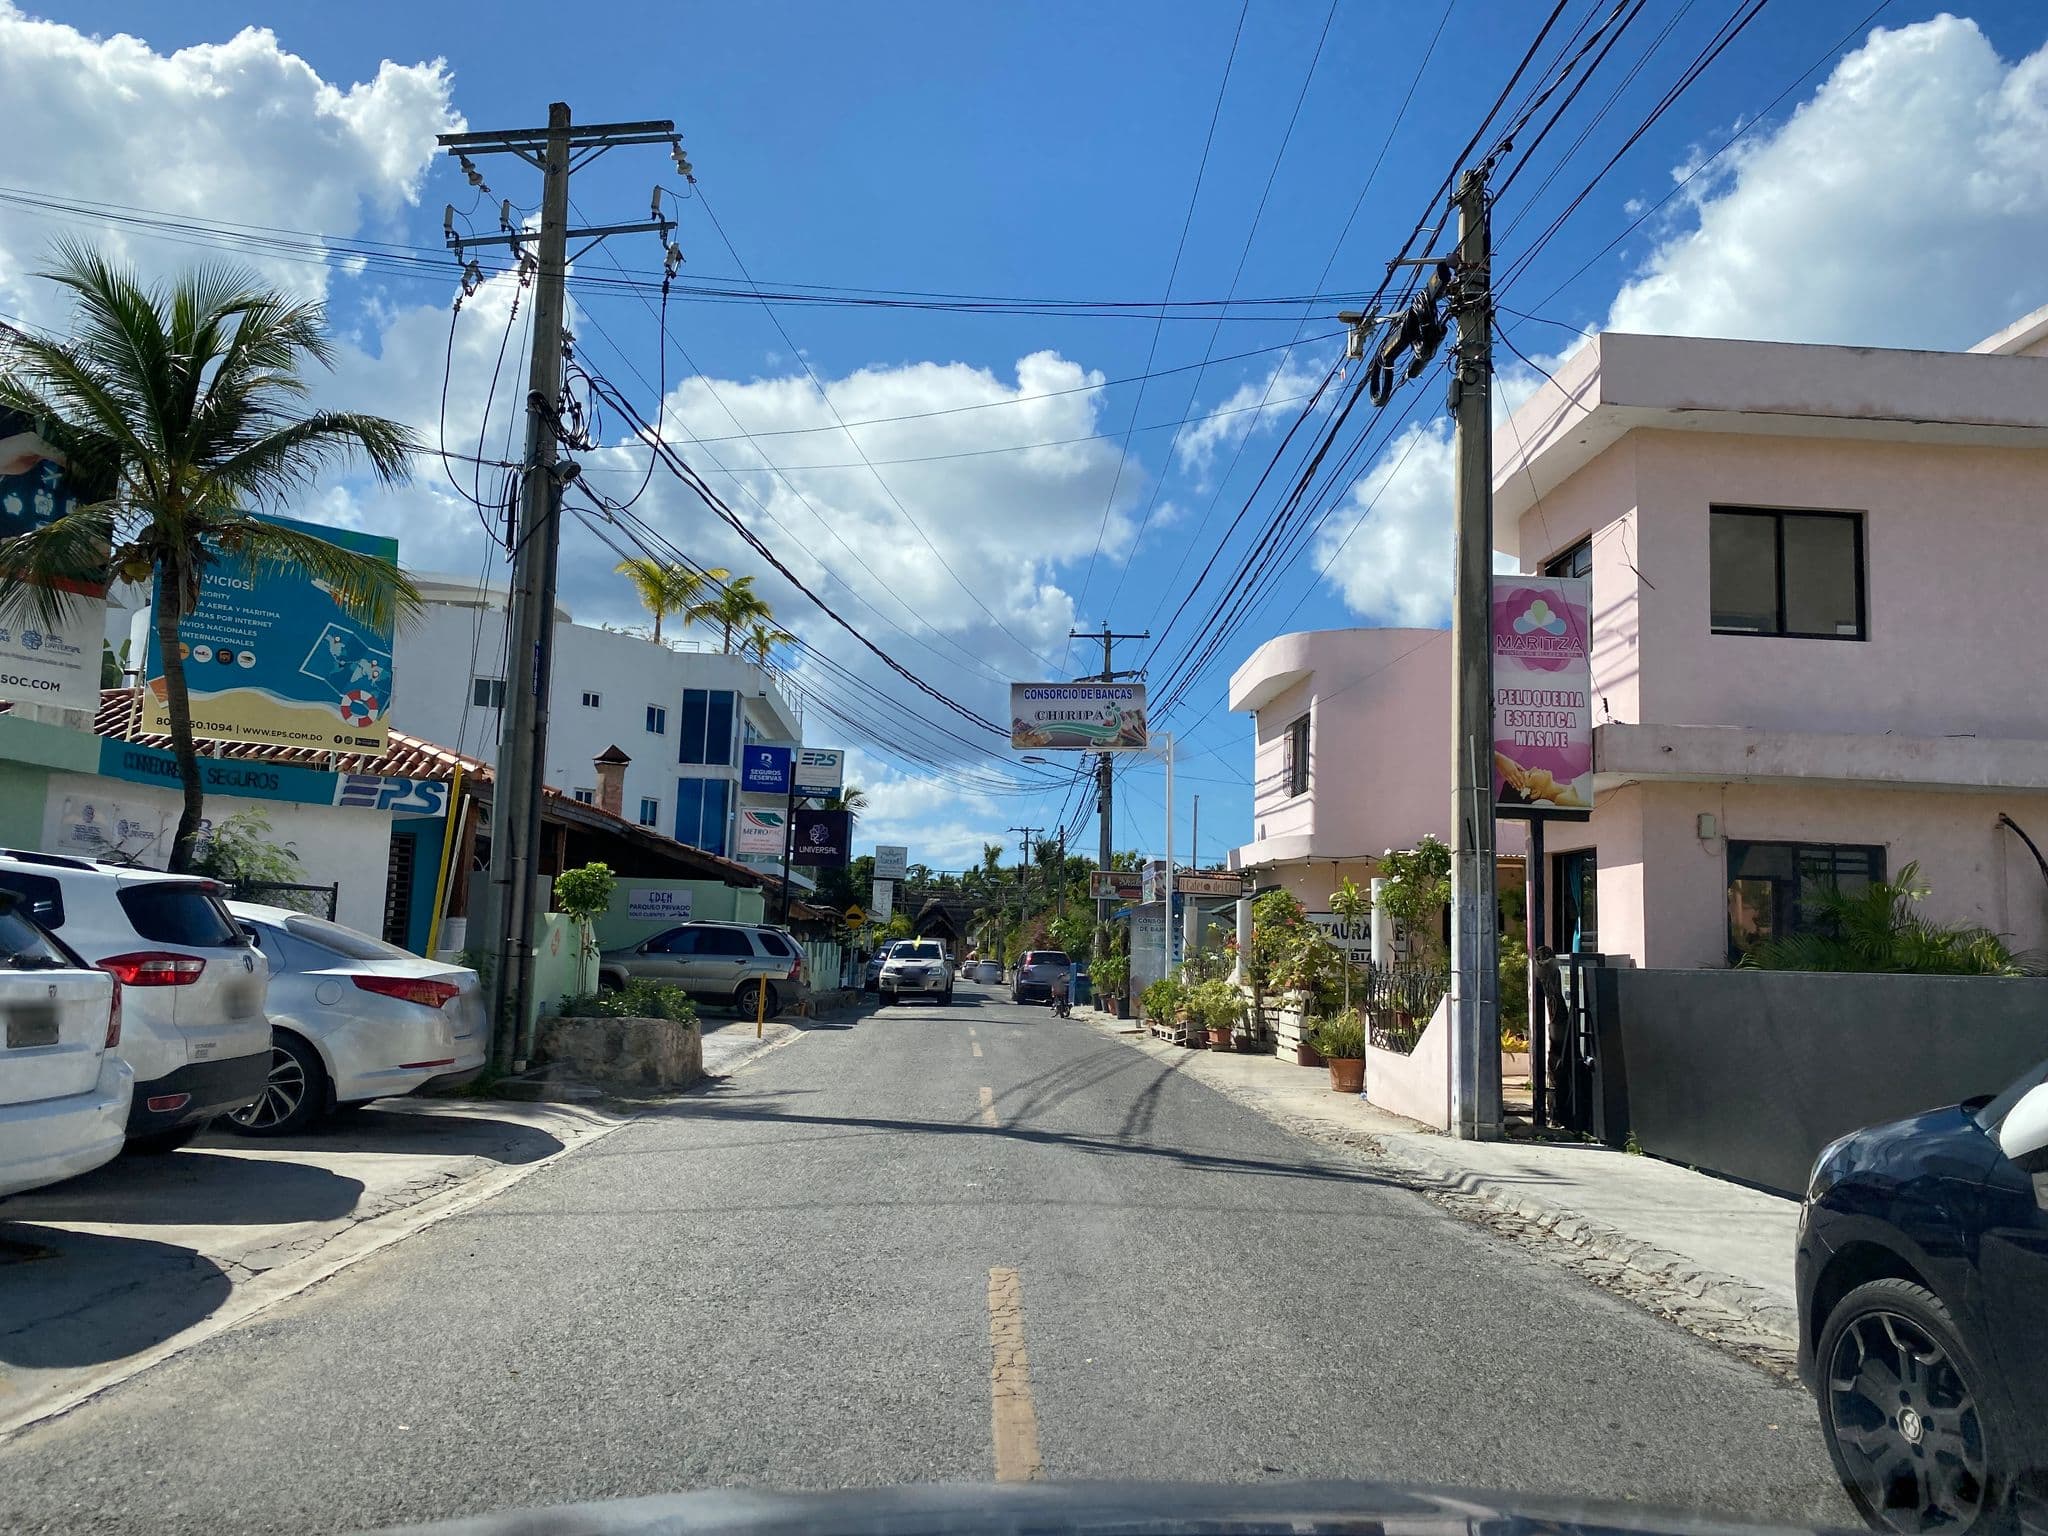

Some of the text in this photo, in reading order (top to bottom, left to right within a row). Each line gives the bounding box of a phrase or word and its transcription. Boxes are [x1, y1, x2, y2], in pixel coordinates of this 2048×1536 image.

[207, 601, 233, 612] AEREA
[242, 607, 280, 619] MARITIMA
[180, 620, 258, 637] NVIOS NACIONALES
[216, 614, 233, 622] POR
[235, 617, 272, 628] INTERNET
[181, 631, 255, 647] INTERNACIONALES
[1497, 635, 1583, 652] MARITZA
[1024, 688, 1133, 700] CONSORCIO DE BANCAS
[1498, 688, 1584, 707] PELUQUERIA
[1034, 710, 1104, 721] CHIRIPA
[1505, 710, 1576, 728] ESTETICA
[243, 726, 323, 742] WWW.EPS.COM.DO
[1515, 731, 1568, 748] MASAJE
[800, 752, 837, 766] EPS
[207, 767, 279, 791] SEGUROS
[749, 774, 782, 782] RESERVAS
[750, 768, 781, 776] SEGUROS
[341, 775, 444, 815] EPS
[799, 846, 839, 855] UNIVERSAL
